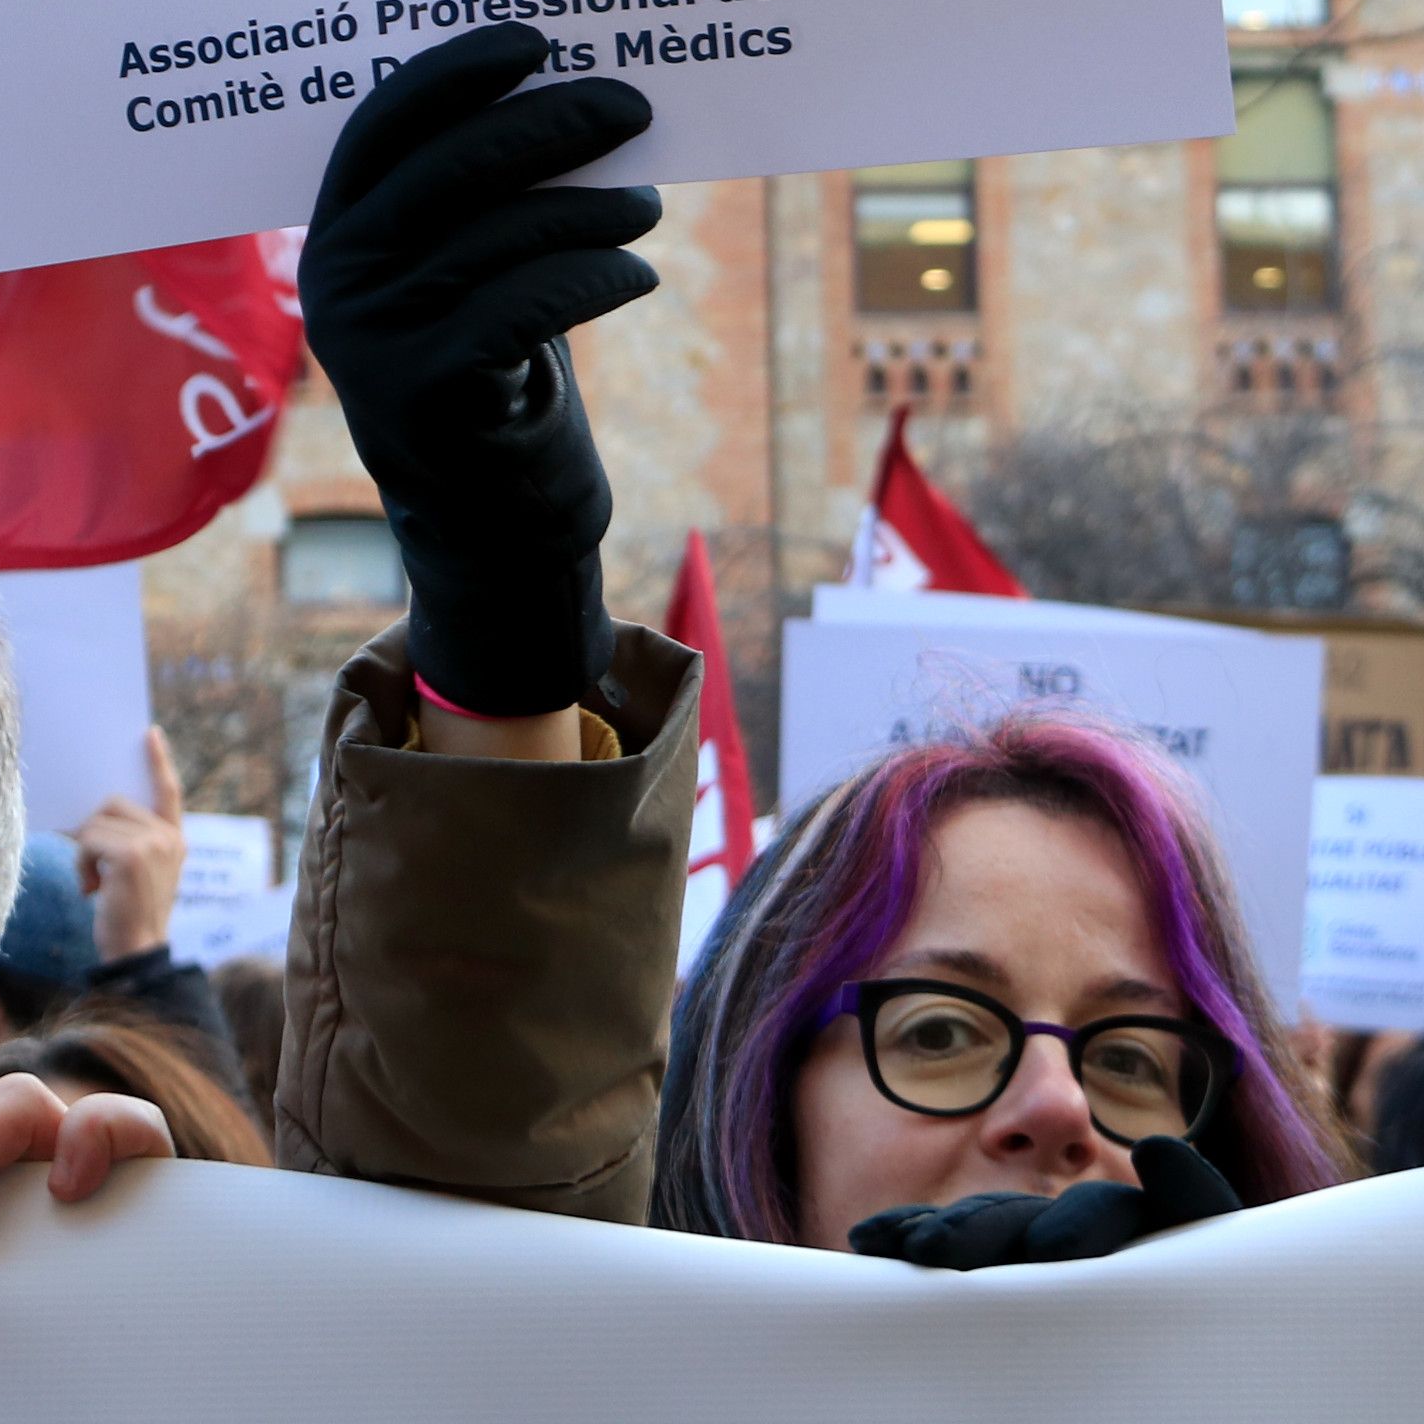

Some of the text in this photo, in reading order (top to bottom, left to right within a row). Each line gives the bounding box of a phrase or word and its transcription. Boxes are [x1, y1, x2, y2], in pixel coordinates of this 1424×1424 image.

[120, 2, 357, 77] Associació
[127, 81, 285, 132] Comitè
[300, 66, 355, 104] de
[615, 22, 792, 67] Mèdics
